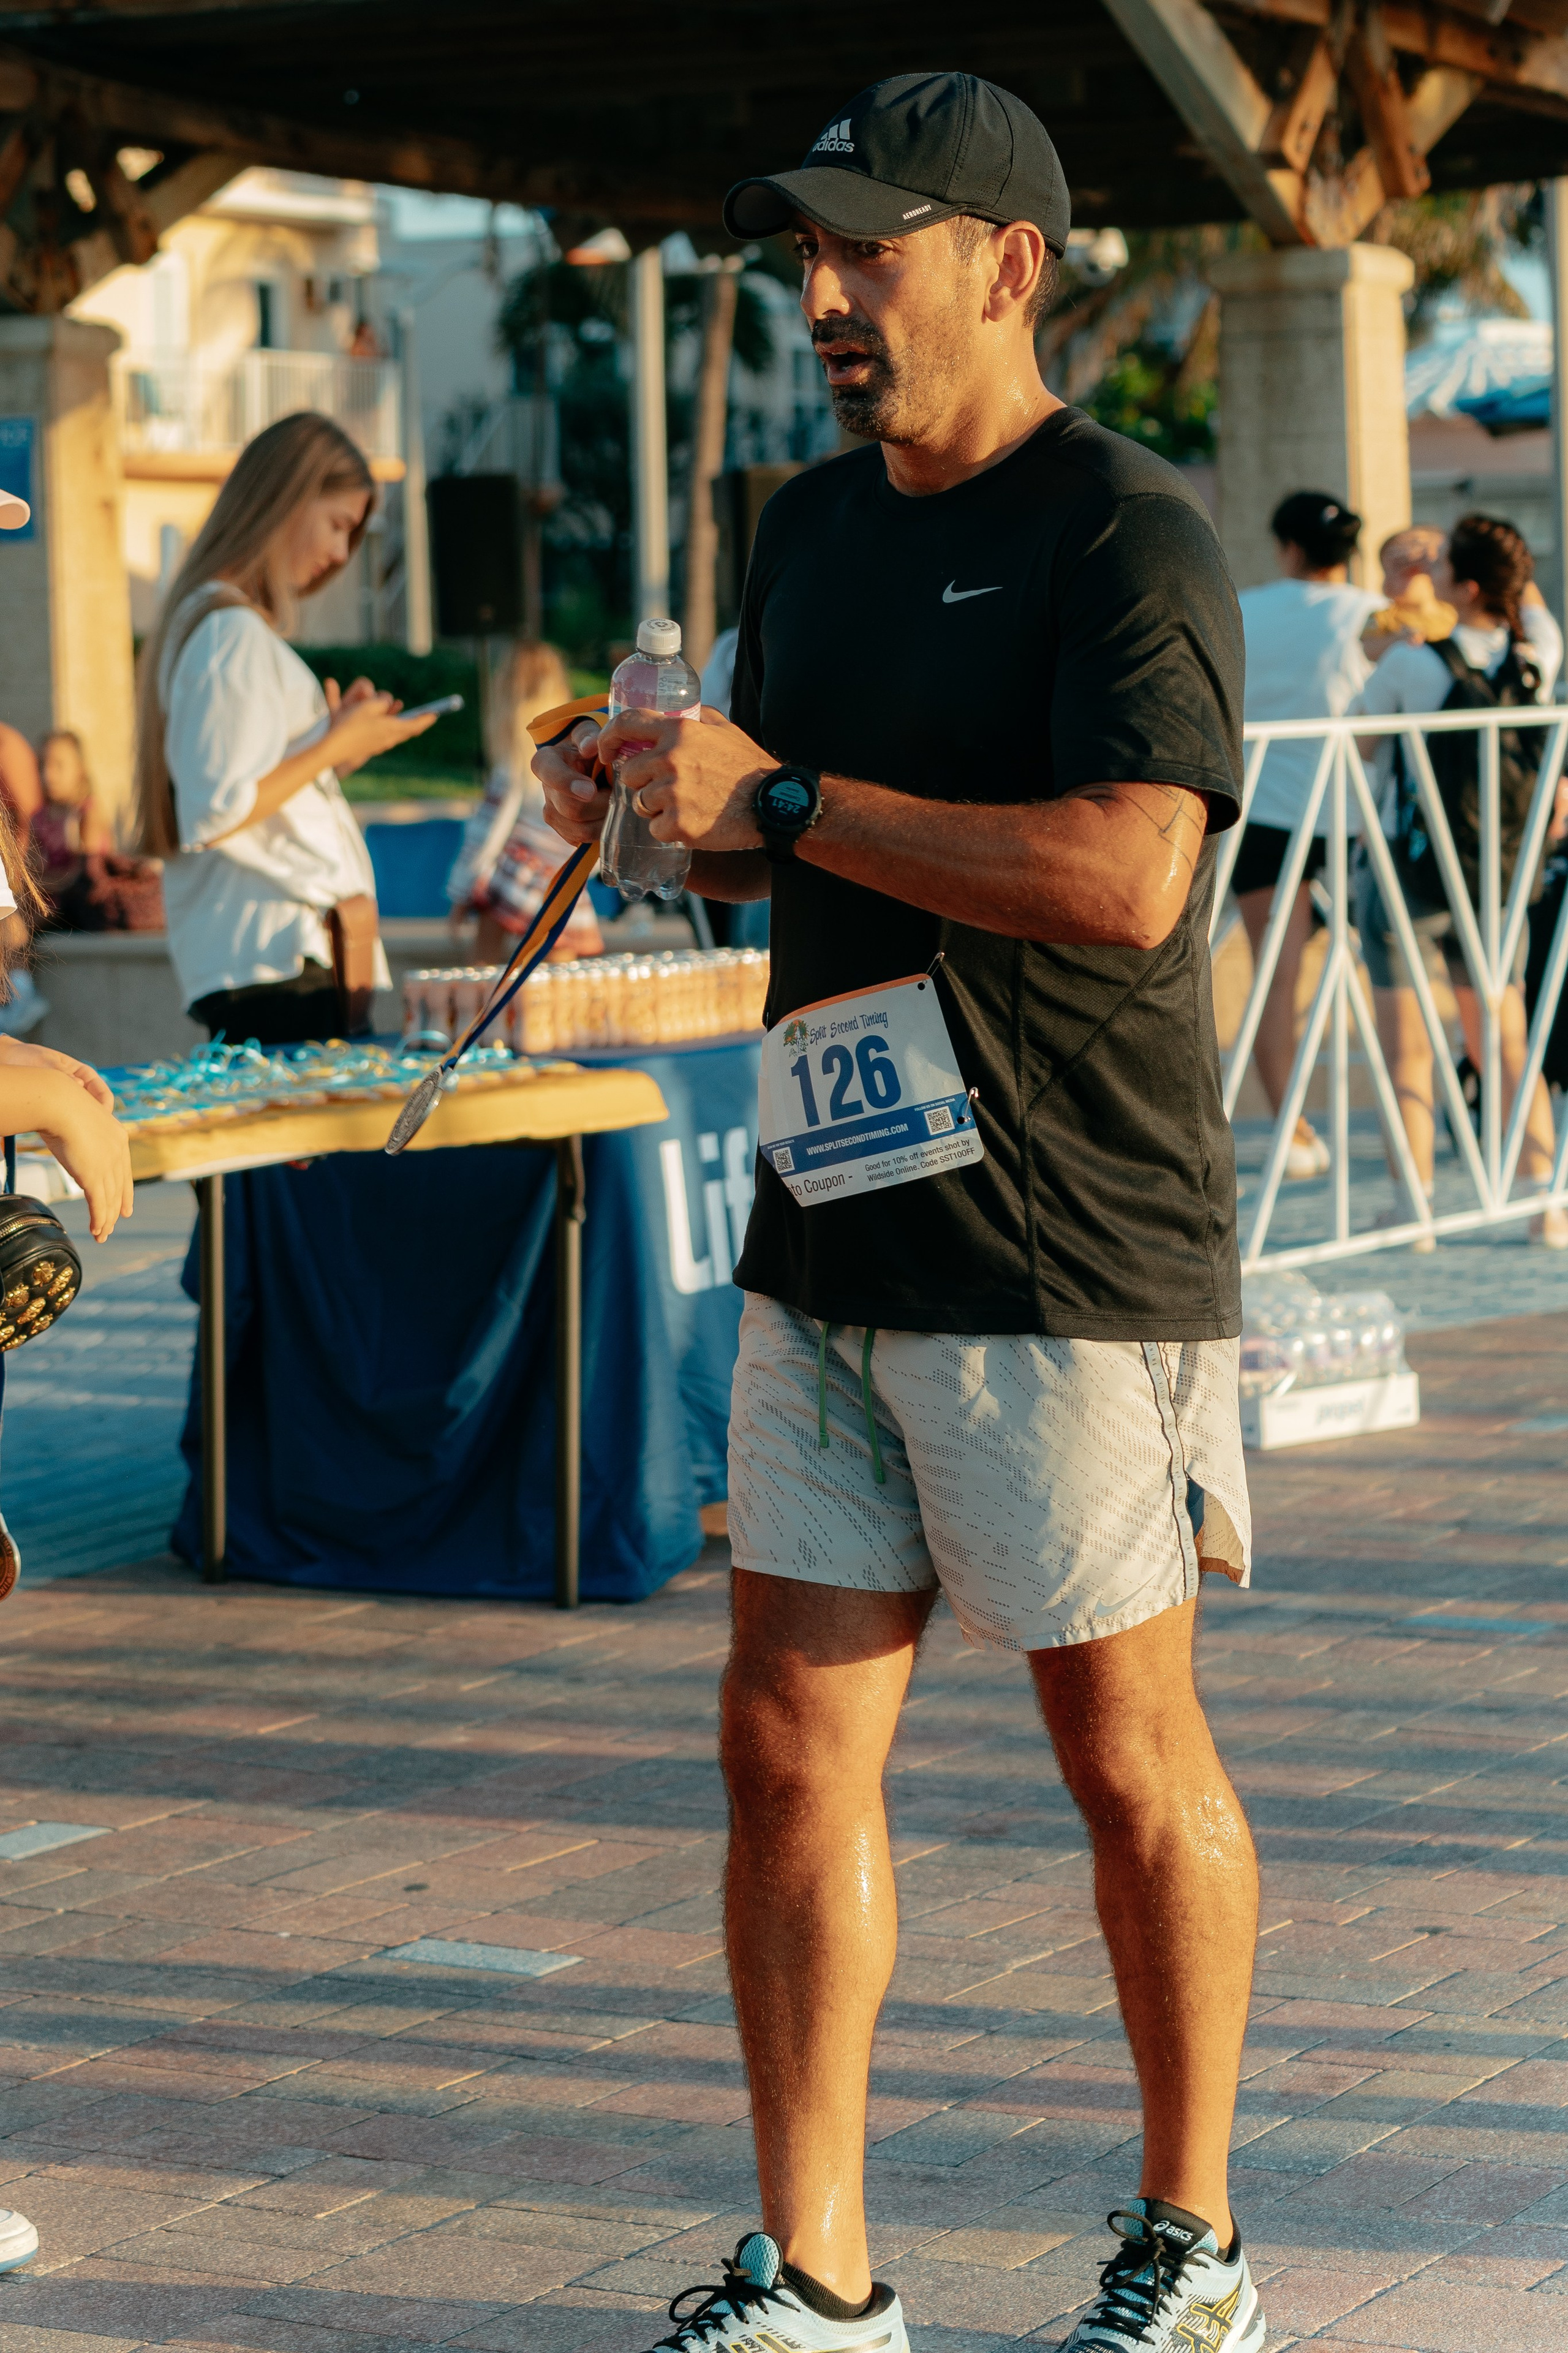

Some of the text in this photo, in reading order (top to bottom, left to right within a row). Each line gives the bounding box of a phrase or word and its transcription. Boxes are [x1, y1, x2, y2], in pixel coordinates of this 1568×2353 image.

[812, 138, 854, 153] adidas
[902, 204, 932, 220] AEROREADY
[810, 1011, 889, 1045] Split Second Timing
[791, 1035, 902, 1128] 126
[806, 1123, 909, 1155] WWW.SPLITSECONDTIMING.COM
[865, 1161, 881, 1172] Good
[892, 1155, 908, 1165] 10%
[909, 1152, 919, 1161] off
[920, 1147, 944, 1158] events
[944, 1141, 960, 1150] shot
[867, 1170, 894, 1182] Wildside
[895, 1165, 920, 1175] Online.
[920, 1160, 938, 1169] Code
[804, 1174, 845, 1193] Coupon
[1147, 1342, 1157, 1366] NNING
[1166, 2226, 1194, 2241] asics
